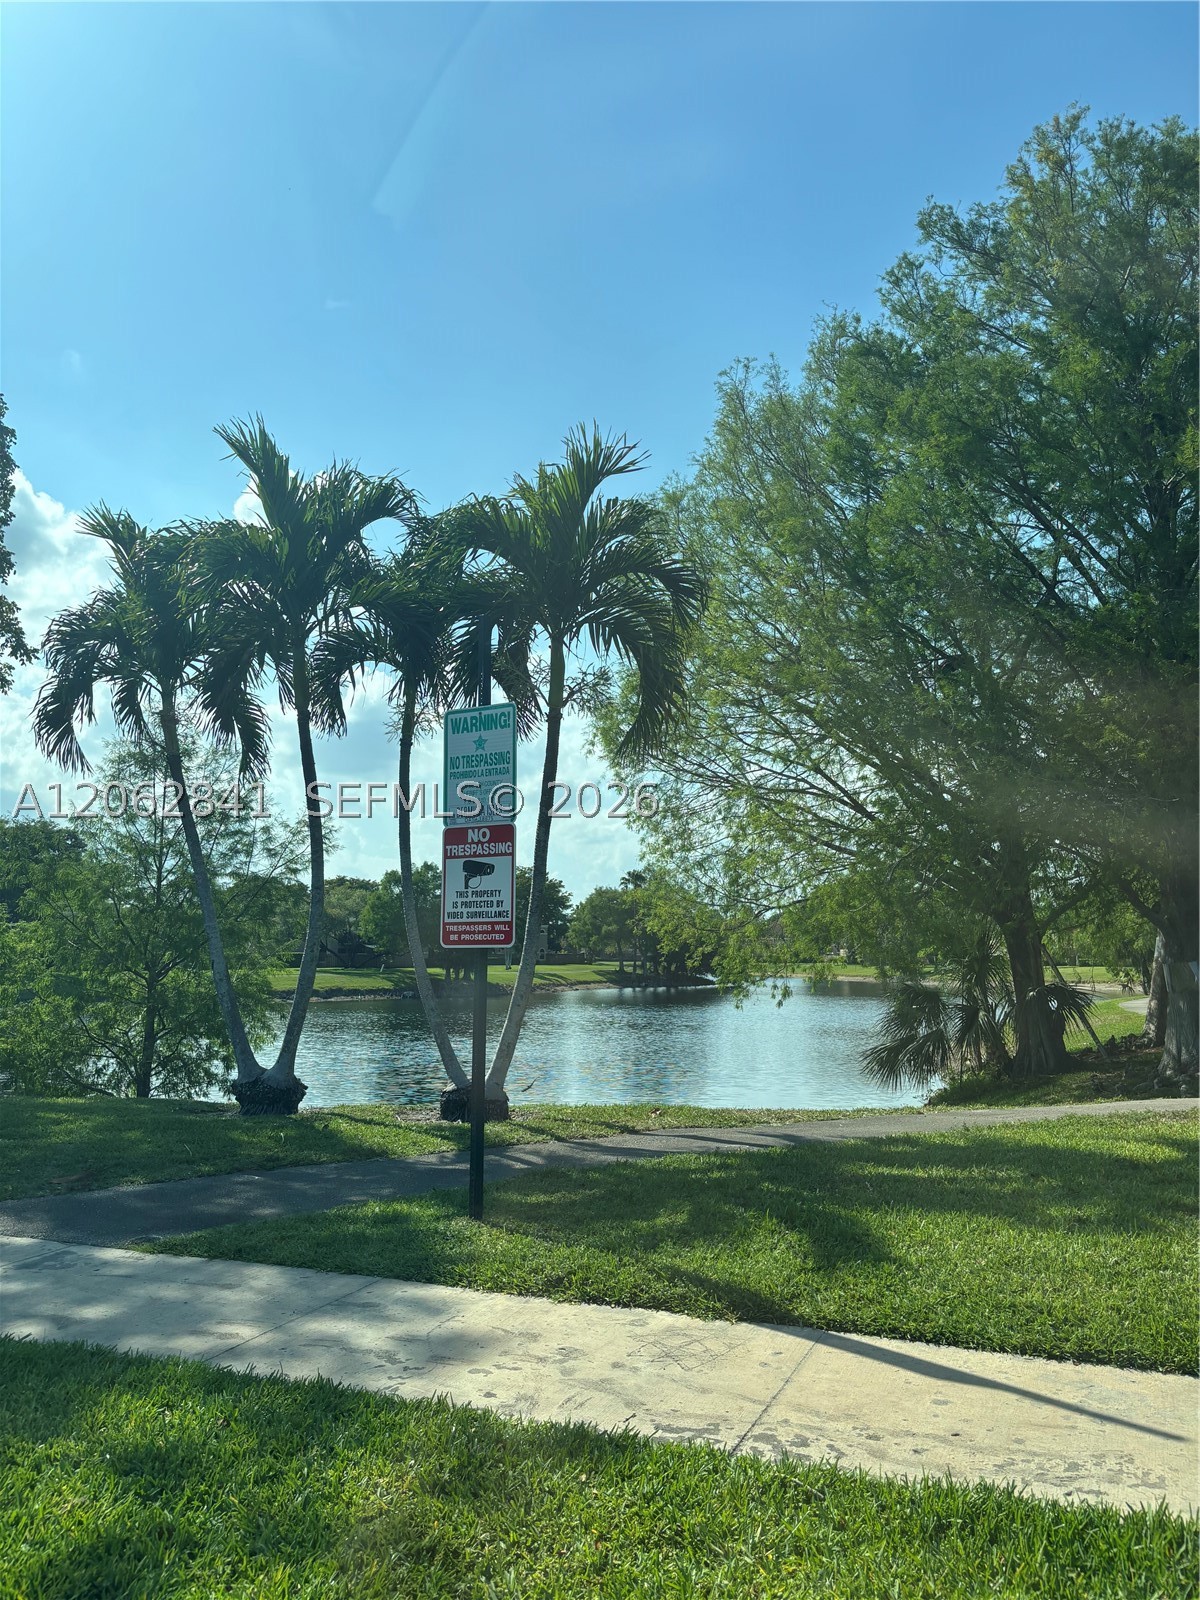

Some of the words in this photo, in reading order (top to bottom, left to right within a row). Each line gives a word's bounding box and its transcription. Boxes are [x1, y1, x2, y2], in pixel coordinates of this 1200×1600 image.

[451, 712, 511, 735] WARNING!
[450, 755, 460, 770] NO
[461, 751, 510, 769] TRESPASSING
[450, 770, 477, 780] PROHIBIDO
[477, 769, 485, 778] LA
[485, 767, 510, 777] ENTRADA
[467, 828, 491, 843] NO
[446, 842, 513, 856] TRESPASSING
[455, 891, 469, 899] THIS
[471, 889, 502, 898] PROPERTY
[452, 901, 458, 909] IS
[460, 900, 494, 909] PROTECTED
[496, 900, 504, 908] BY
[447, 911, 463, 920] VIDEO
[466, 910, 510, 919] SURVEILLANCE
[446, 924, 492, 932] TRESPASSERS
[460, 933, 505, 941] PROSECUTED
